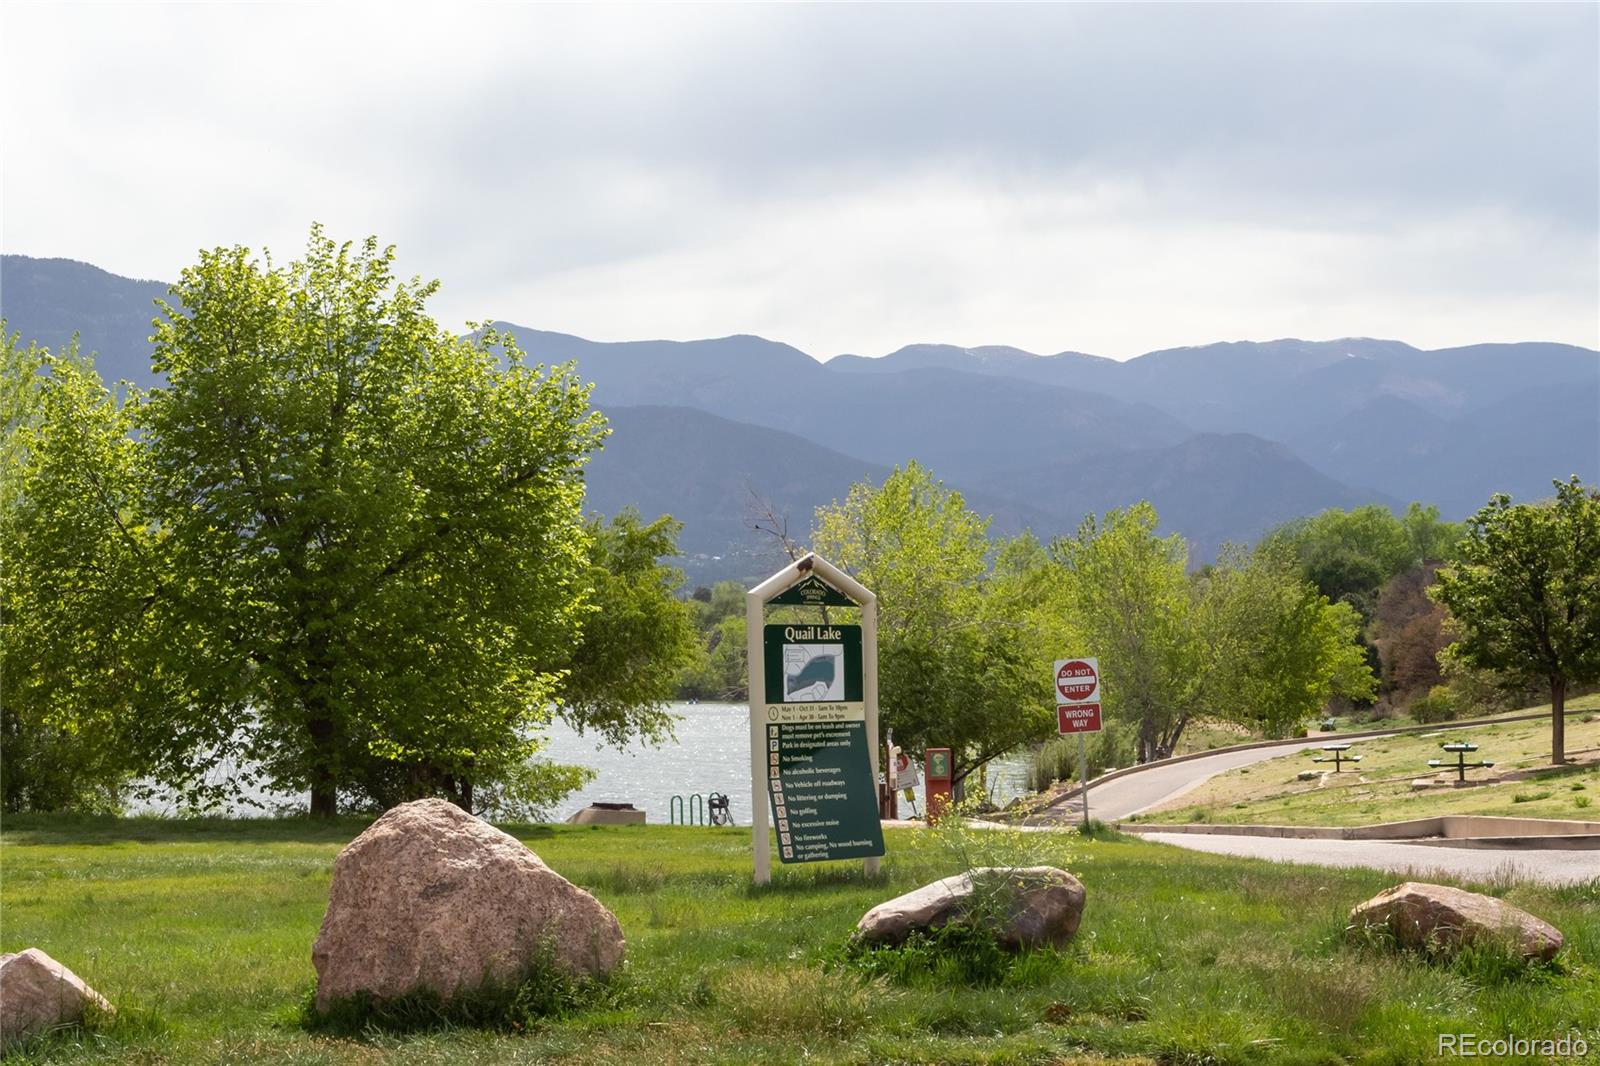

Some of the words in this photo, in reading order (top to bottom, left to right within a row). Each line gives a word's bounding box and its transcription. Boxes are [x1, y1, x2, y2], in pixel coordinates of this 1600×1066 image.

[784, 626, 814, 642] Quail
[817, 626, 842, 640] Lake
[1064, 685, 1090, 694] ENTER
[1065, 709, 1094, 718] WRONG
[782, 724, 794, 732] Dogs
[1072, 720, 1088, 728] WAY
[800, 740, 825, 749] designated
[799, 808, 817, 816] golfing
